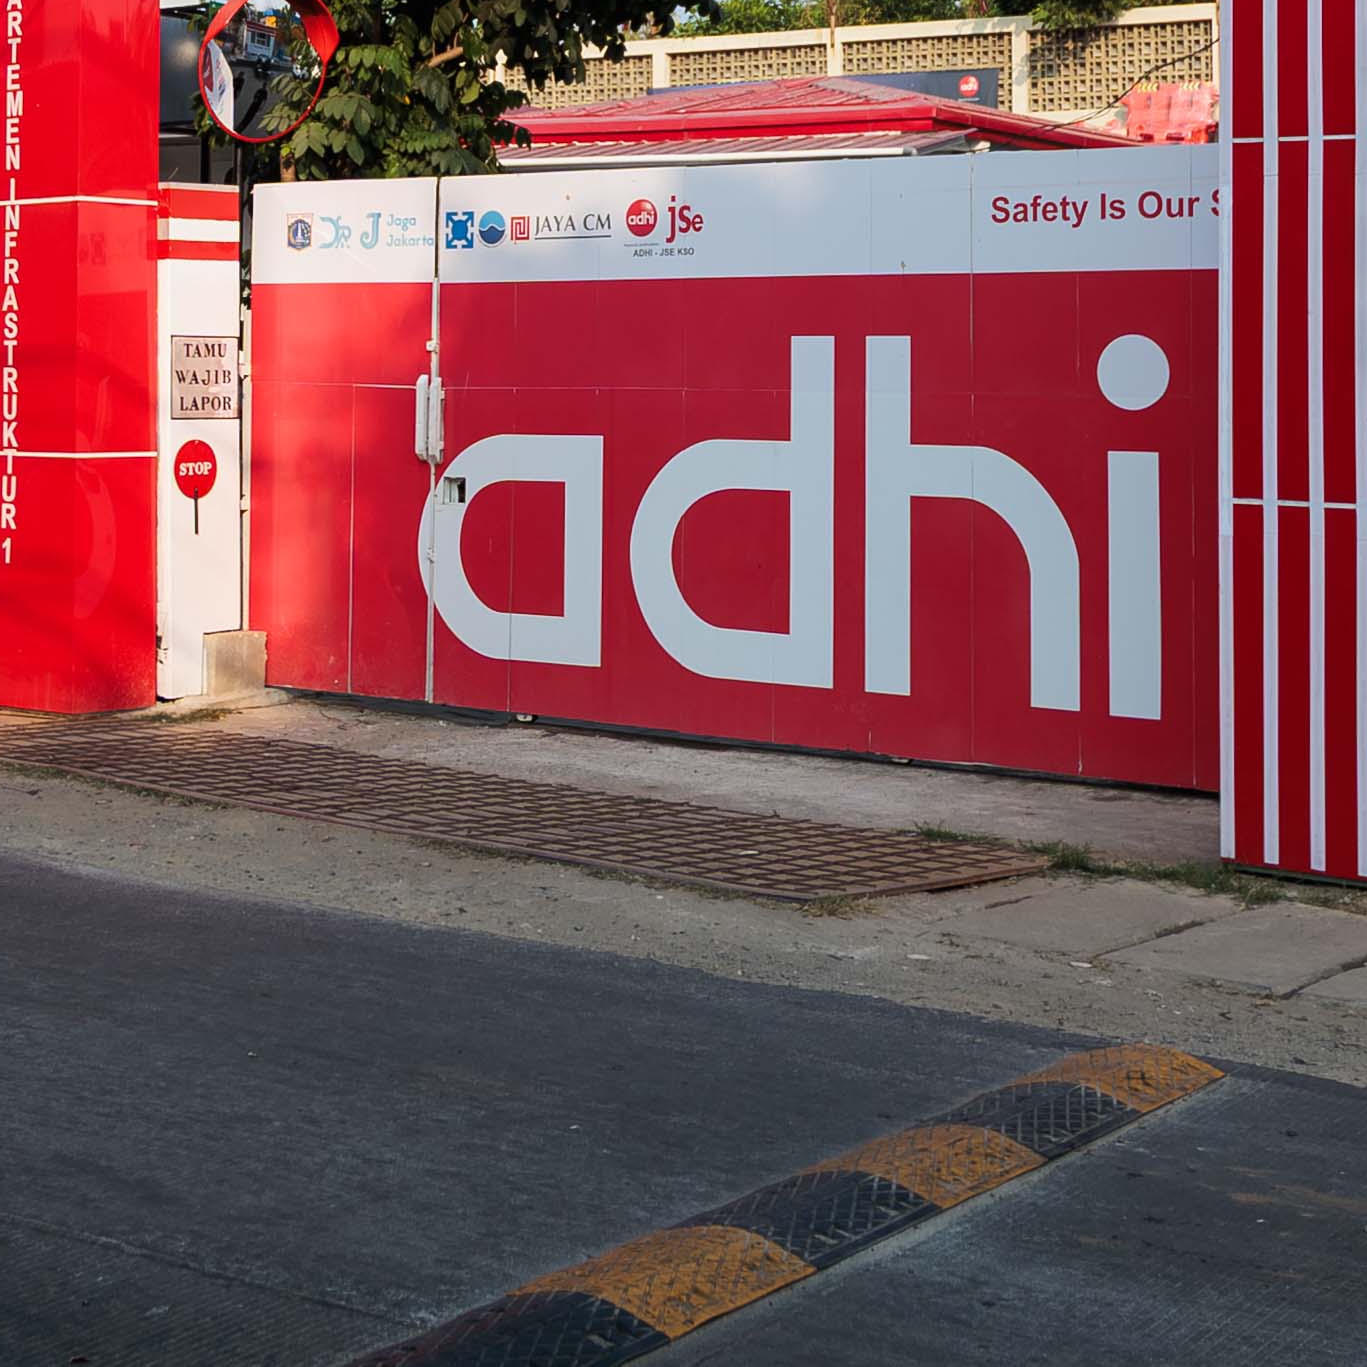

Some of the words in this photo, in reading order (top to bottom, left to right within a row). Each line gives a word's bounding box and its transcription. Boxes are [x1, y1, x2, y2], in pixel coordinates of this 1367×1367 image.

[628, 209, 654, 225] adhi
[991, 194, 1089, 228] Safety
[1100, 192, 1126, 220] Is
[1138, 190, 1200, 219] Our
[386, 213, 417, 232] Jaga
[535, 215, 576, 236] JAYA
[583, 213, 612, 231] CM
[386, 234, 434, 248] Jakarta
[633, 249, 653, 257] ADHI
[659, 248, 675, 256] JSE
[677, 247, 695, 256] KSO
[1, 177, 20, 529] INFRASTRUKTUR
[183, 343, 227, 358] TAMU
[176, 369, 232, 386] WAJIB
[180, 396, 232, 411] LAPOR
[179, 461, 213, 476] STOP
[418, 333, 1171, 721] adhi
[1, 537, 11, 564] 1
